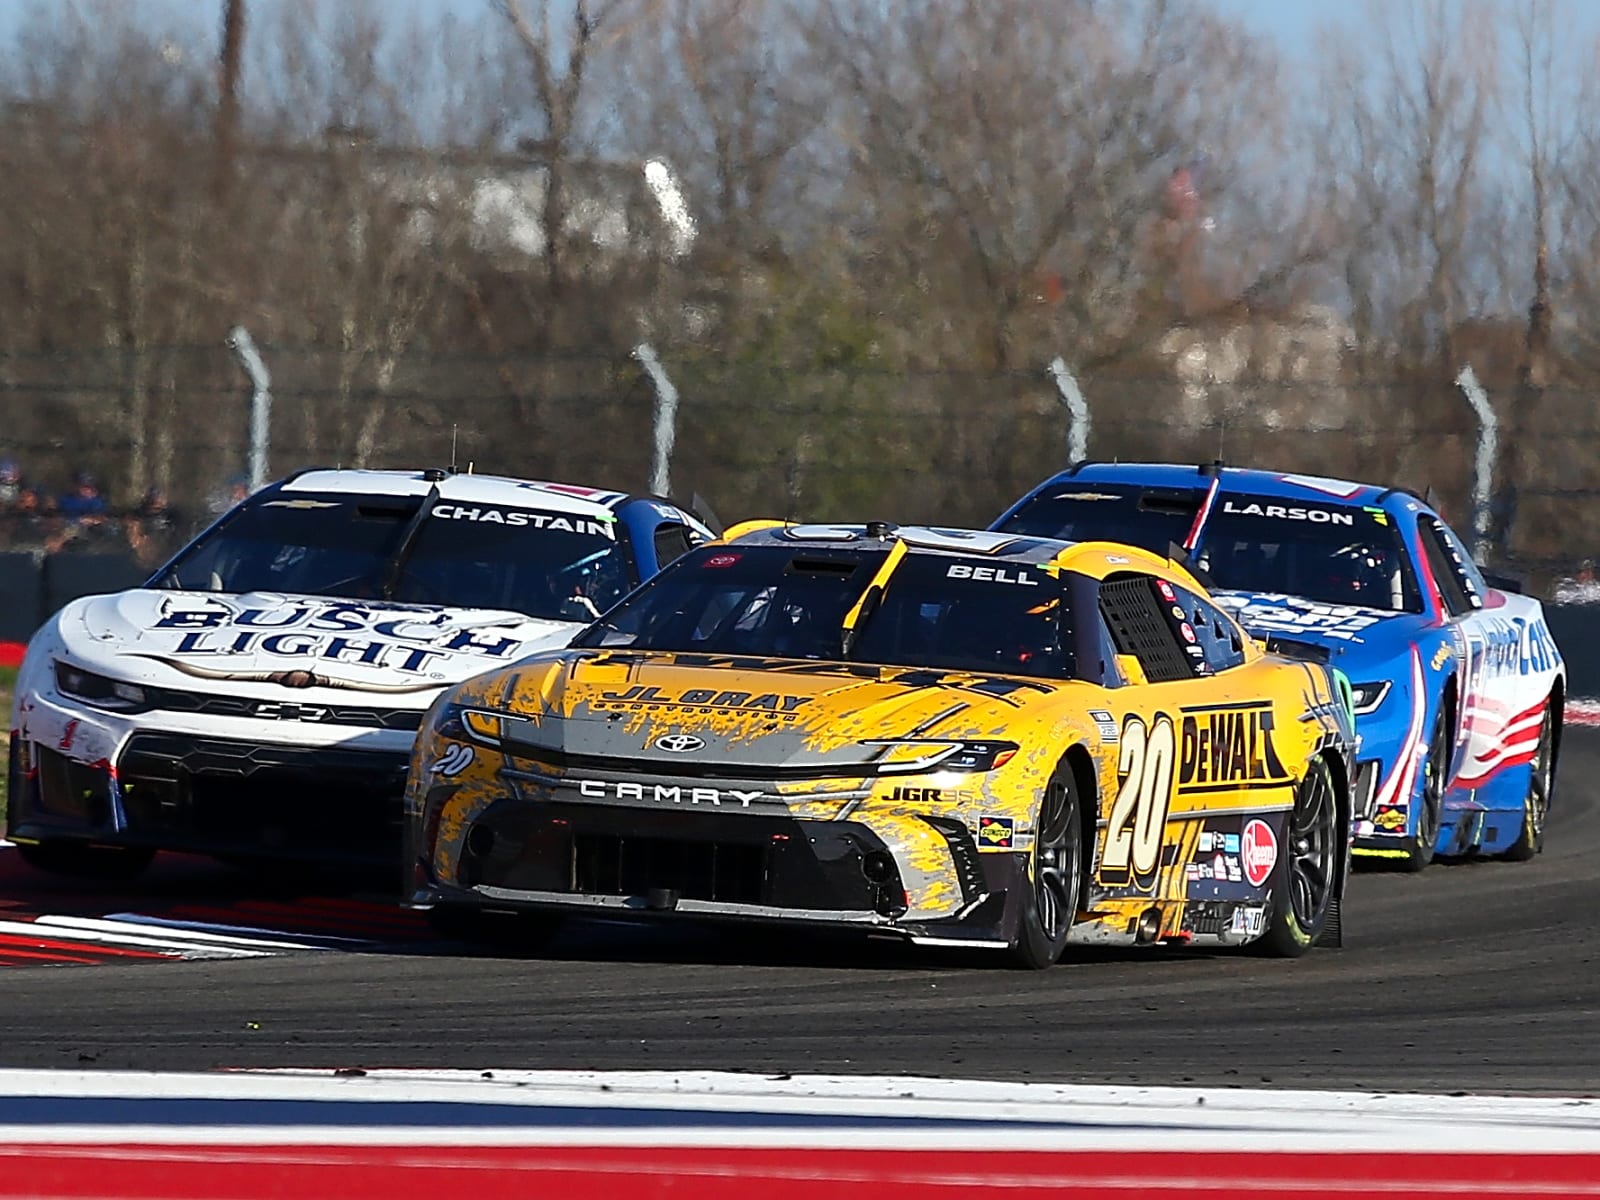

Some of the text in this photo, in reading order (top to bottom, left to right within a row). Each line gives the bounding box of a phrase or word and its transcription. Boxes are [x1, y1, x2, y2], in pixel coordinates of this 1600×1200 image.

[431, 504, 613, 538] CHASTAIN
[1223, 501, 1354, 526] LARSON
[946, 564, 1039, 586] BELL
[152, 597, 522, 659] BUSCH
[173, 631, 447, 675] LIGHT
[602, 686, 671, 702] JL
[431, 744, 475, 777] 20
[580, 779, 764, 807] CAMRY
[1099, 711, 1175, 891] 20
